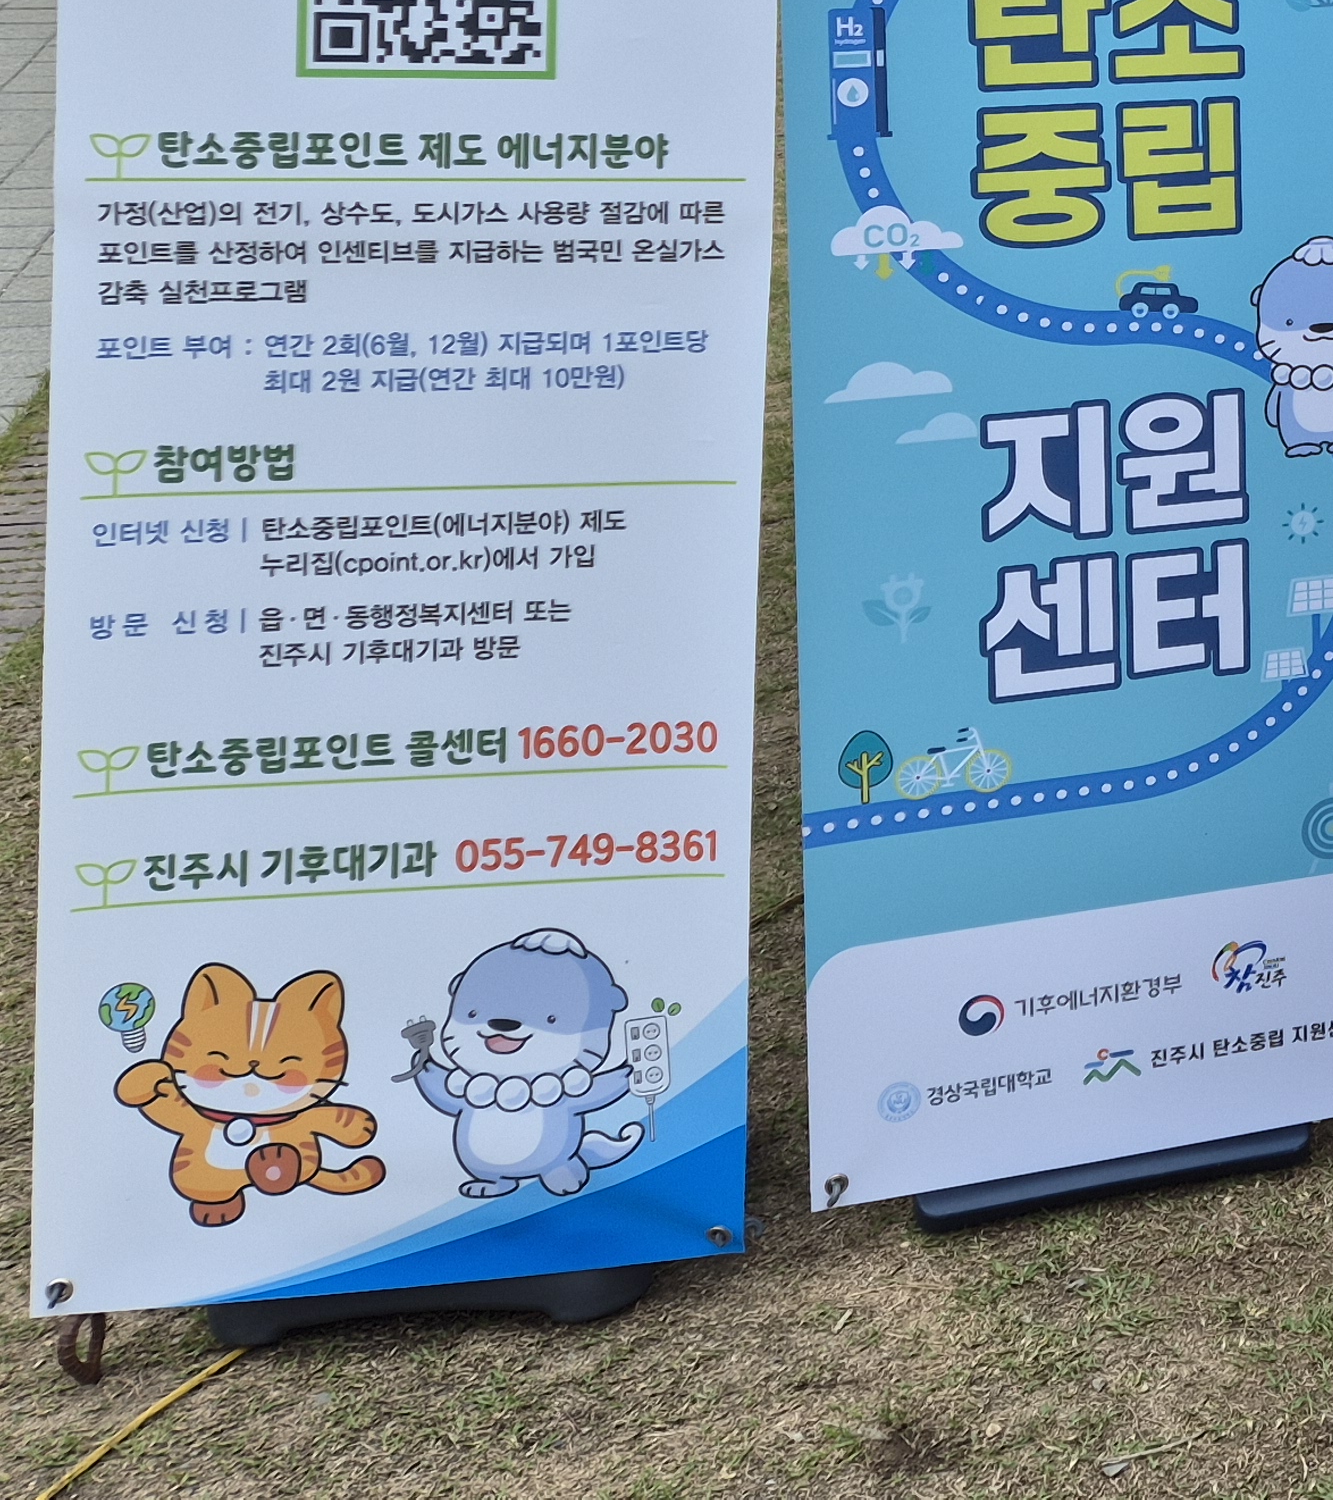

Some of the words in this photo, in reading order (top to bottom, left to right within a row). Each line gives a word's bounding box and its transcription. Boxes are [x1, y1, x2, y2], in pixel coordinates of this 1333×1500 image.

[156, 130, 408, 170] 탄소중립포인트
[417, 132, 487, 170] 제도
[496, 132, 670, 170] 에너지분야
[970, 97, 1242, 249] 중립
[97, 200, 242, 227] 가정(산업)의
[253, 201, 310, 228] 전기,
[320, 201, 402, 227] 상수도,
[412, 201, 510, 226] 도시가스
[516, 201, 590, 226] 사용량
[599, 201, 670, 225] 절감에
[678, 201, 727, 225] 따른
[97, 240, 200, 266] 포인트를
[207, 240, 308, 266] 산정하여
[317, 239, 439, 265] 인센티브를
[448, 239, 545, 264] 지급하는
[552, 238, 623, 263] 범국민
[631, 238, 727, 263] 온실가스
[97, 280, 150, 306] 감축
[157, 279, 309, 306] 실천프로그램
[95, 336, 174, 361] 포인트
[182, 334, 232, 360] 부여
[264, 333, 315, 358] 연간
[321, 331, 418, 359] 2회(6월,
[427, 330, 490, 358] 12월)
[496, 329, 592, 356] 지급되며
[601, 328, 710, 355] 1포인트당
[262, 368, 312, 394] 최대
[321, 367, 362, 393] 2원
[370, 365, 477, 393] 지급(연간
[484, 366, 531, 391] 최대
[541, 363, 626, 391] 10만원)
[152, 443, 297, 485] 참여방법
[980, 388, 1249, 541] 지원
[91, 519, 169, 548] 인터넷
[179, 517, 231, 545] 신청
[261, 510, 571, 542] 탄소중립포인트(에너지분야)
[578, 509, 628, 534] 제도
[259, 544, 539, 578] 누리집(cpoint.or.kr)에서
[549, 544, 597, 569] 가입
[523, 598, 573, 624] 또는
[981, 540, 1251, 702] 센터
[258, 641, 334, 669] 진주시
[341, 637, 464, 666] 기후대기과
[473, 635, 522, 662] 방문
[146, 731, 396, 780] 탄소중립포인트
[405, 726, 508, 768] 콜센터
[517, 720, 719, 760] 1660-2030
[142, 848, 249, 894] 진주시
[259, 838, 438, 887] 기후대기과
[454, 828, 719, 874] 055-749-8361
[1013, 972, 1184, 1019] 기후에너지환경부
[1150, 1040, 1206, 1070] 진주시
[1212, 1027, 1286, 1059] 탄소중립
[926, 1066, 1053, 1107] 경상국립대학교
